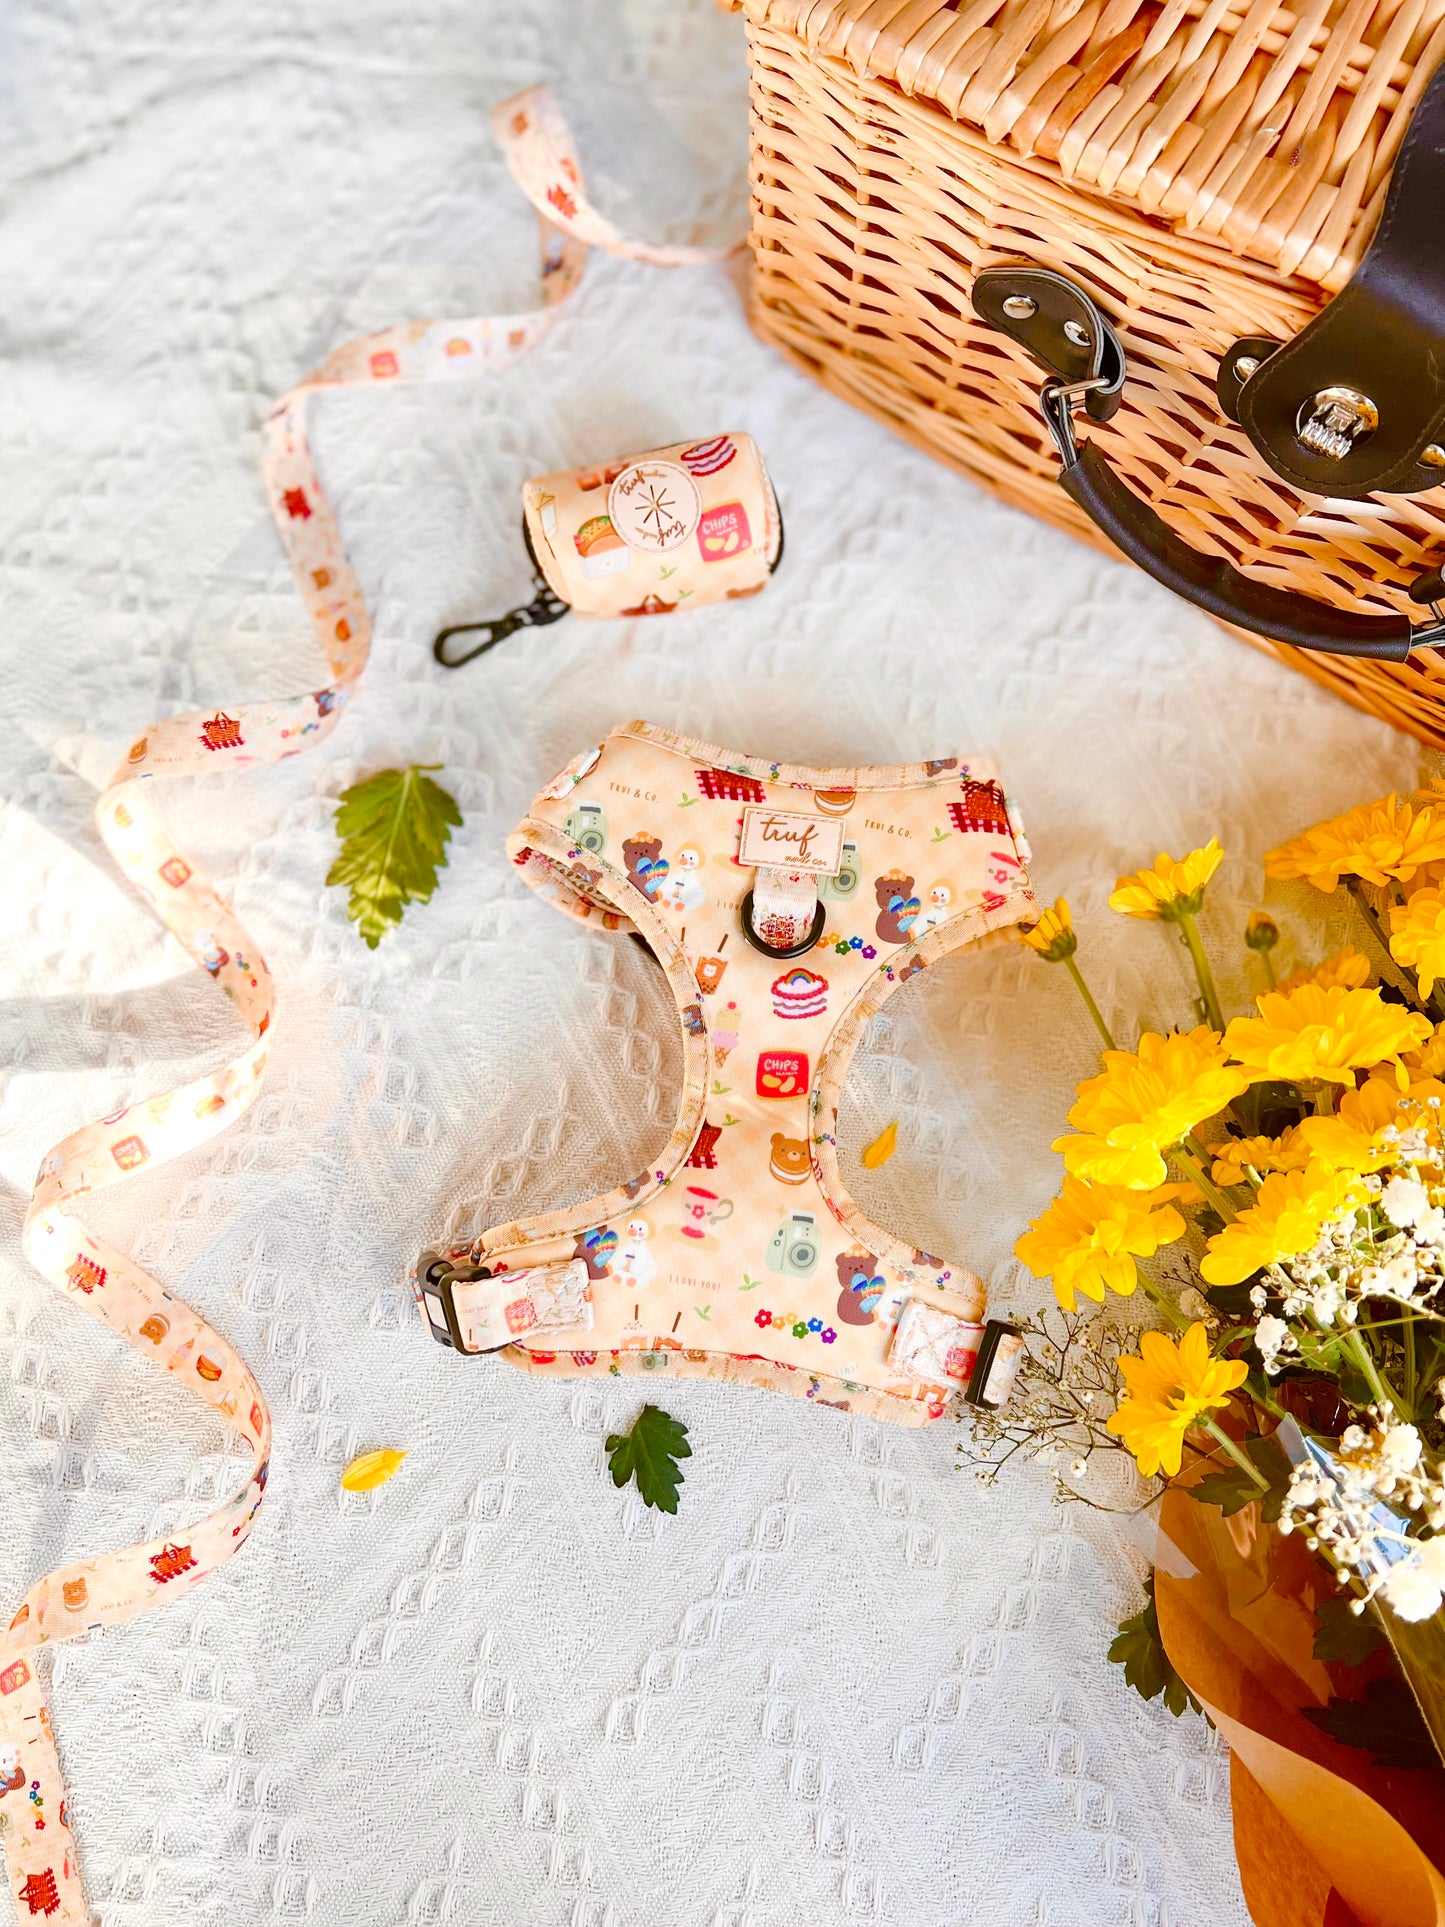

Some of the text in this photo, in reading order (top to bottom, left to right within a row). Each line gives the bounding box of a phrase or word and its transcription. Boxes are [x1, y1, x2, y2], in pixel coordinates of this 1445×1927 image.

[619, 469, 646, 496] truf
[701, 512, 738, 535] CHIPS
[657, 520, 687, 547] truf
[633, 788, 641, 798] &
[760, 816, 820, 857] truf
[887, 824, 895, 834] &
[784, 851, 812, 865] and
[763, 1058, 799, 1072] CHIPS
